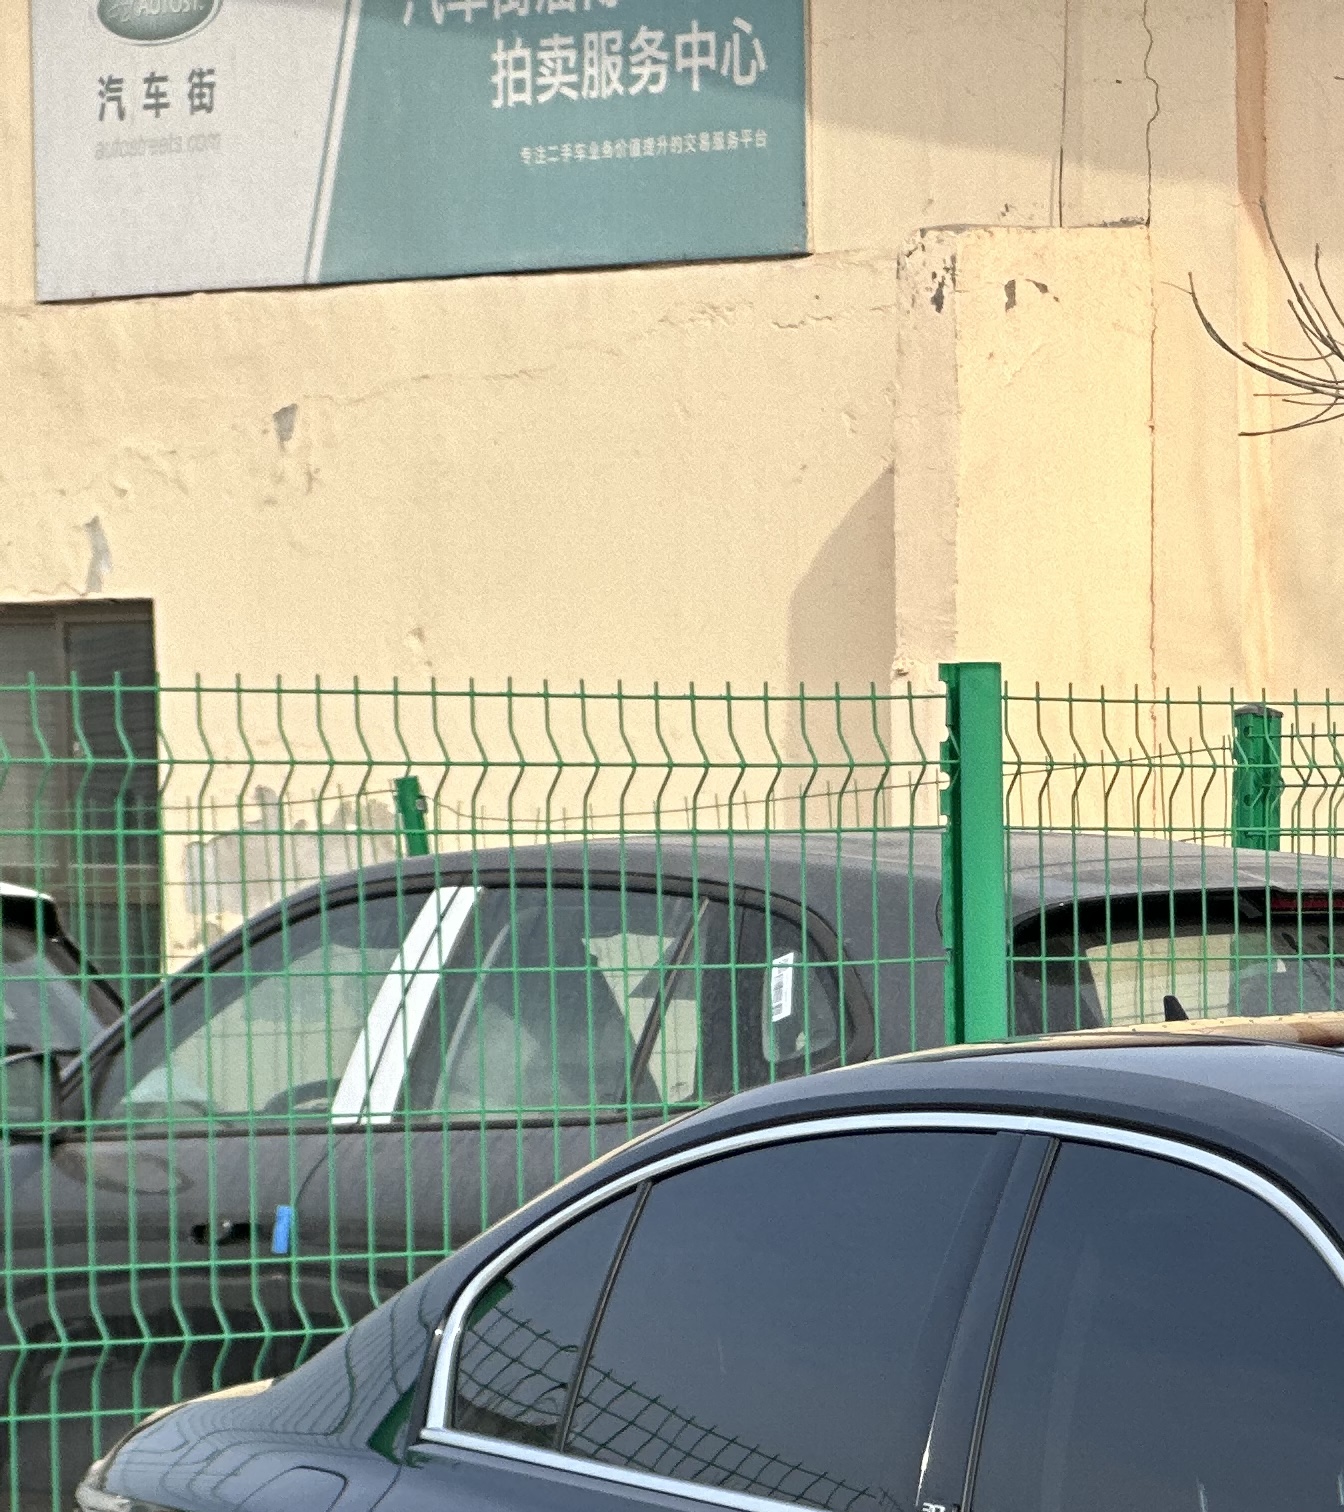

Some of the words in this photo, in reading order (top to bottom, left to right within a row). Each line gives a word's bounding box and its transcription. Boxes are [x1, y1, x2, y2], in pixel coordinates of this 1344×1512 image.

[98, 67, 215, 121] 汽车街
[491, 17, 768, 108] 拍卖服务中心
